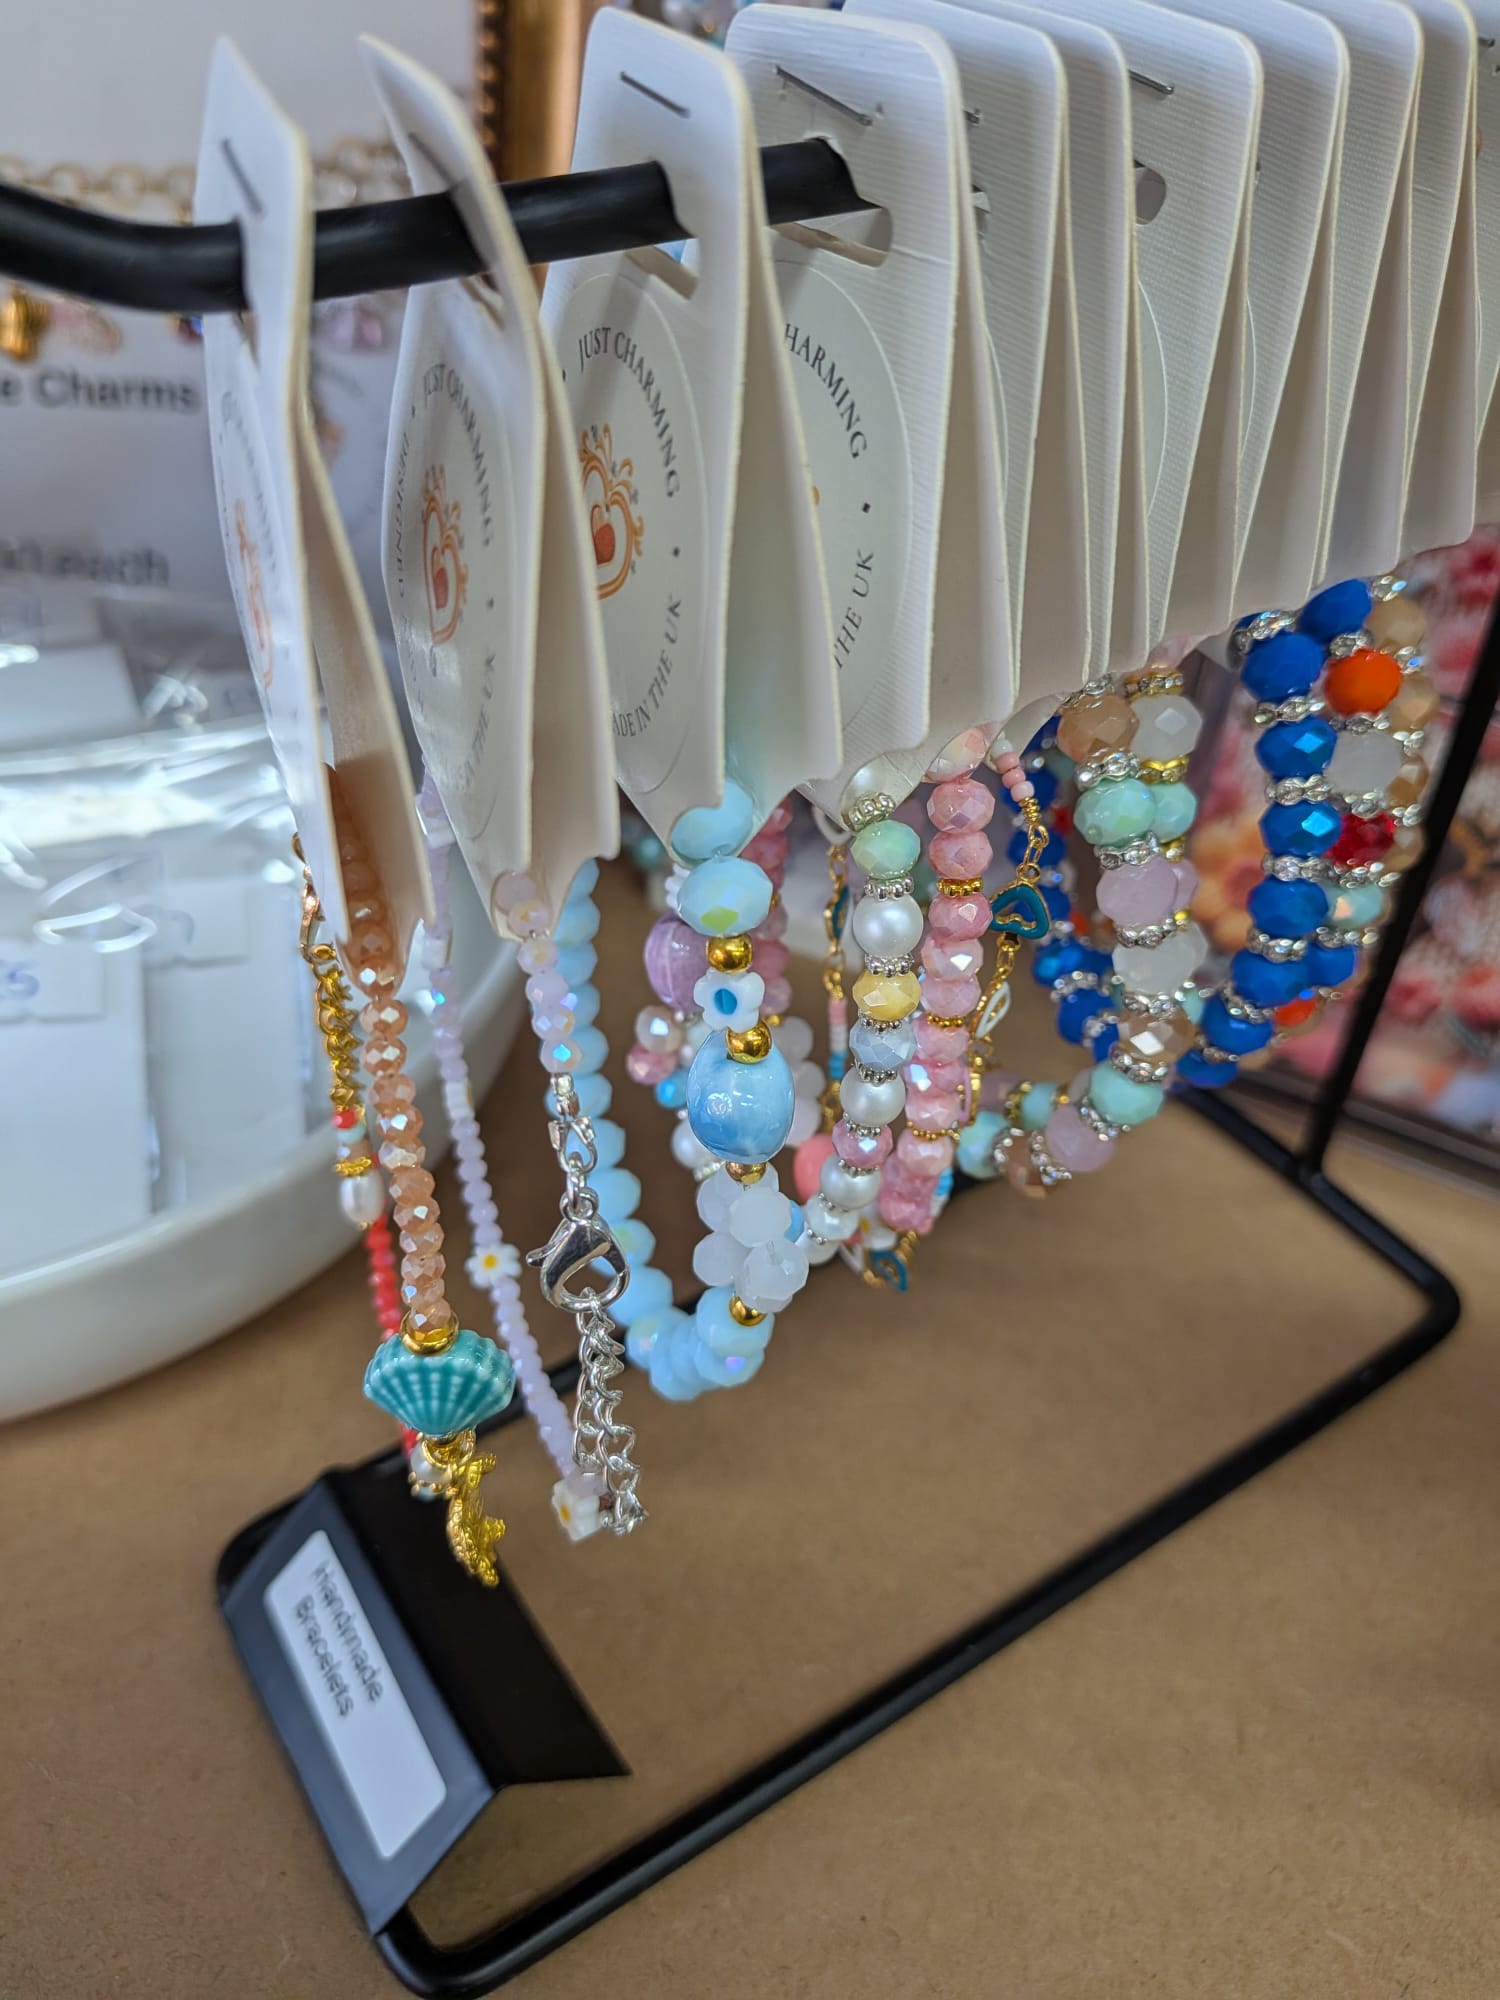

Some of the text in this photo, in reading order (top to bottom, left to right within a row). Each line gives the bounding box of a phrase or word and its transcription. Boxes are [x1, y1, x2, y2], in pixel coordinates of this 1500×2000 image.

[36, 364, 203, 415] Charms
[579, 327, 681, 498] JUST CHARMING
[784, 322, 868, 459] HARMING
[852, 547, 874, 598] UK
[612, 594, 682, 737] ADE IN THE UK
[296, 1593, 355, 1718] Bracelets
[311, 1559, 384, 1702] Handmade
